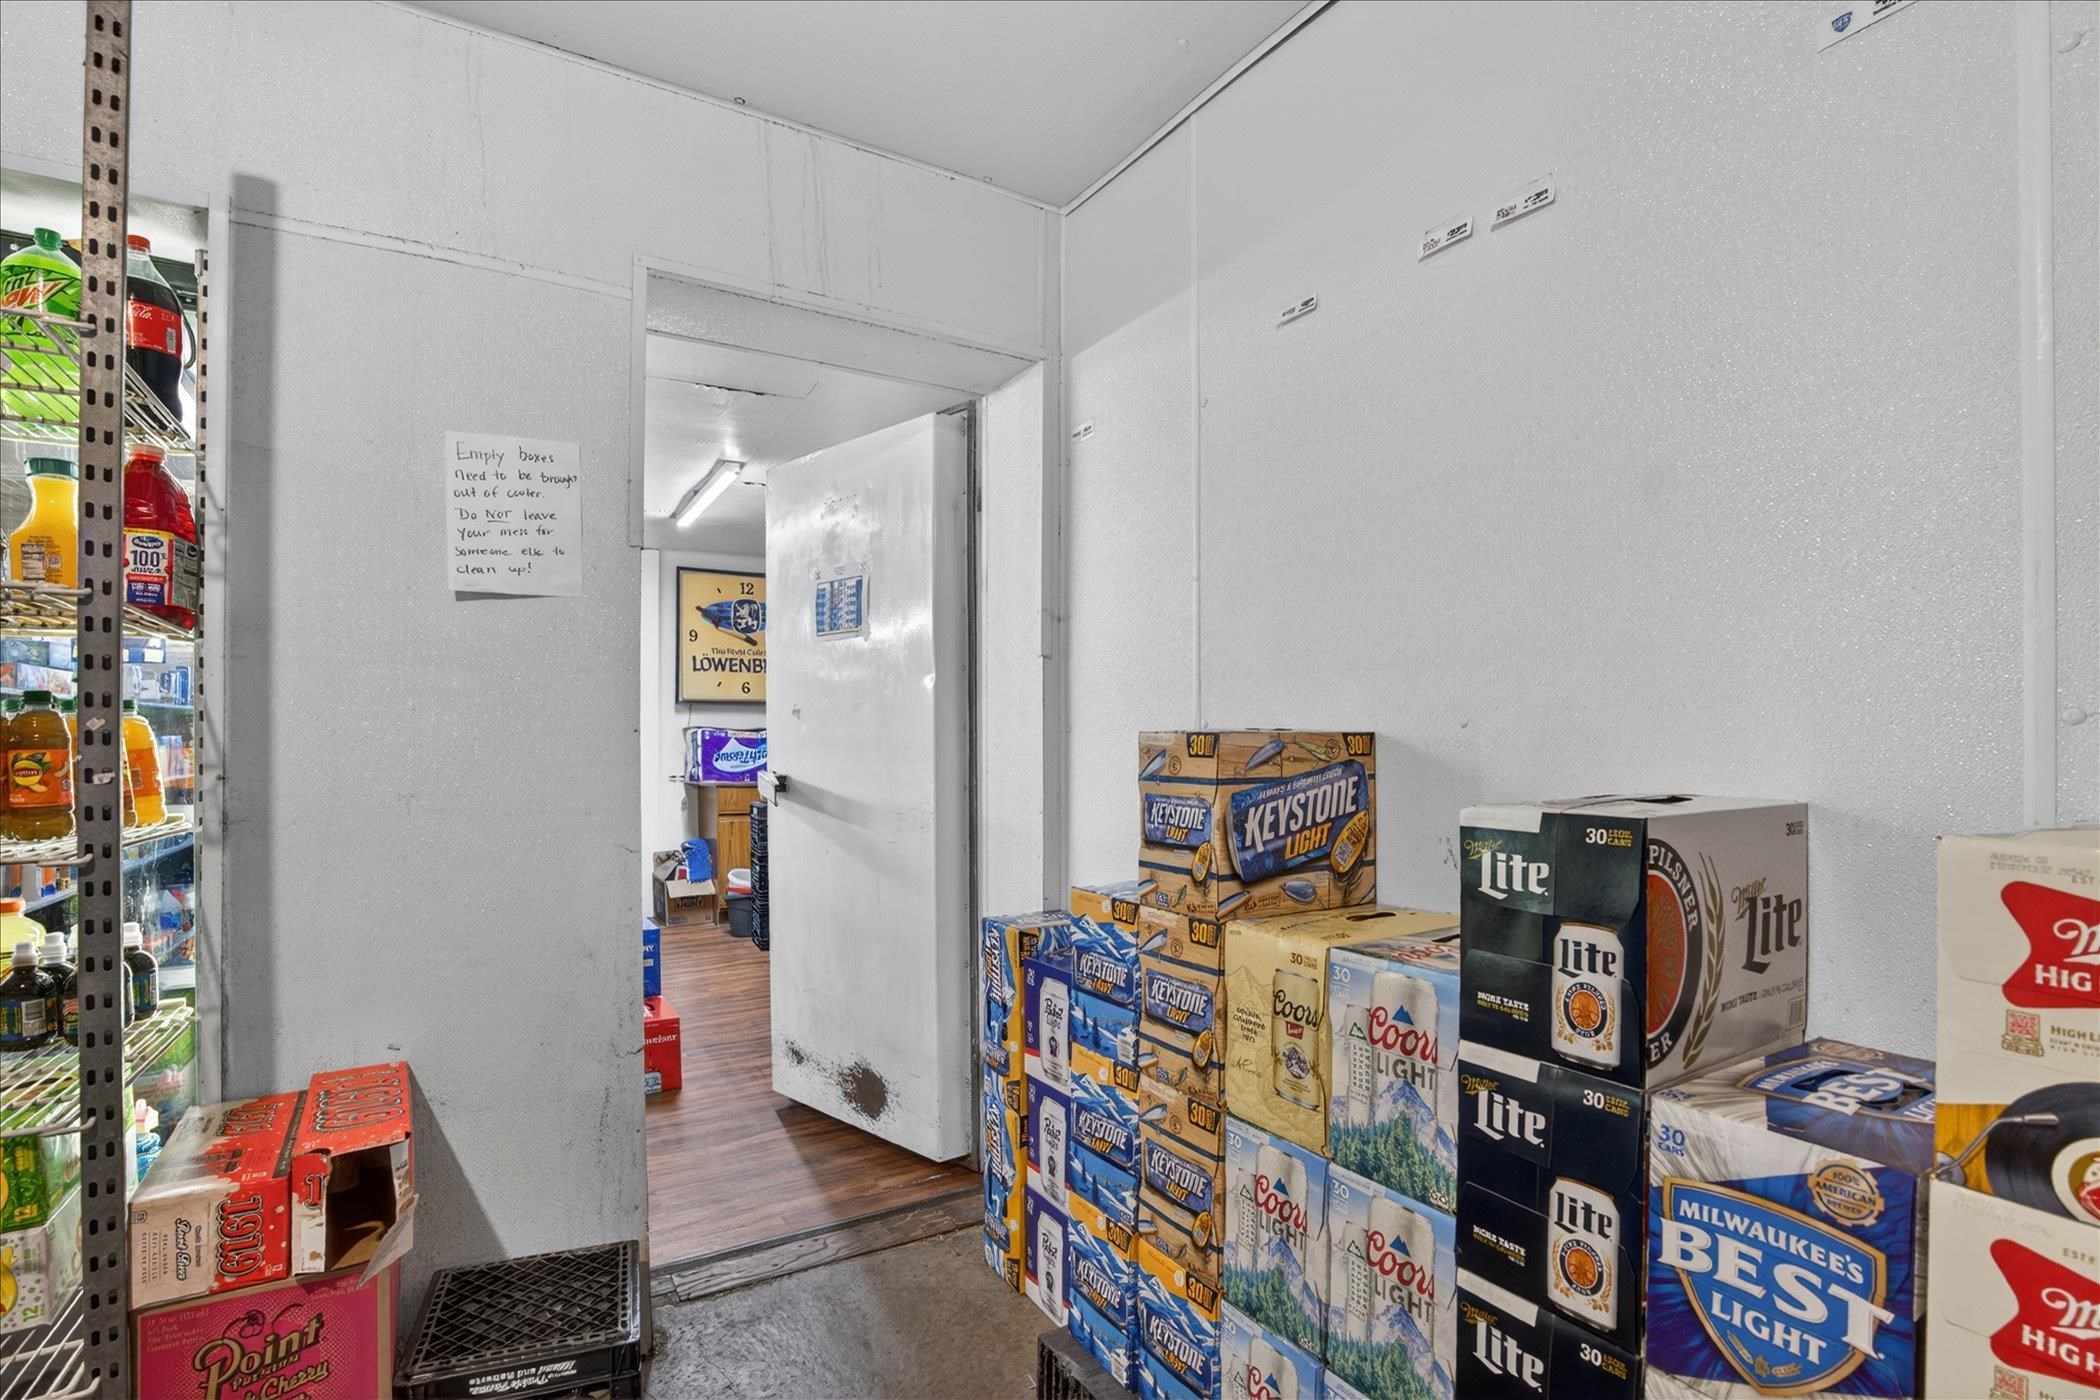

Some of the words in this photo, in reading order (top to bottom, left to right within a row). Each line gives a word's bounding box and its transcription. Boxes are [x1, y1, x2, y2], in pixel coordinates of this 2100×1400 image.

[456, 441, 504, 467] Empty
[519, 445, 554, 463] boxes
[453, 486, 477, 498] out
[483, 486, 499, 498] of
[493, 470, 507, 480] to
[518, 469, 532, 480] be
[454, 507, 477, 520] Do
[524, 509, 558, 520] leave
[536, 524, 555, 535] for
[508, 562, 532, 576] up!
[553, 546, 565, 555] to
[739, 582, 754, 596] 12
[688, 629, 698, 642] 9
[741, 681, 750, 694] 6
[1189, 734, 1205, 756] 30
[1347, 735, 1363, 756] 30
[1151, 801, 1207, 830] KEYSTONE
[1244, 775, 1359, 853] KEYSTONE
[1284, 822, 1333, 860] LIGHT
[1585, 827, 1608, 845] 30
[1476, 850, 1550, 900] Lite
[1650, 844, 1700, 933] PILSNER
[1192, 921, 1208, 943] 30
[1741, 893, 1802, 975] Lite
[1080, 952, 1128, 988] KEYSTONE
[1289, 952, 1303, 966] 30
[1333, 967, 1351, 983] 30
[1557, 937, 1617, 980] Lite
[1151, 979, 1208, 1016] KEYSTONE
[1272, 989, 1320, 1029] Coors
[1368, 1005, 1439, 1065] Coors
[1376, 1052, 1437, 1091] LIGHT
[1460, 1072, 1500, 1095] Miller
[1582, 1089, 1605, 1109] 30
[1802, 1067, 1927, 1116] BEST
[1079, 1109, 1128, 1150] KEYSTONE
[1473, 1086, 1546, 1149] Lite
[1659, 1124, 1686, 1146] 30
[1228, 1133, 1242, 1148] 30
[1151, 1148, 1208, 1200] KEYSTONE
[1331, 1179, 1349, 1199] 30
[1253, 1174, 1309, 1233] Coors
[1553, 1190, 1613, 1241] Lite
[216, 1194, 264, 1278] 1919
[1258, 1211, 1307, 1251] LIGHT
[1679, 1199, 1864, 1285] MILWAUKEE'S
[1076, 1258, 1121, 1309] KEYSTONE
[1366, 1230, 1435, 1301] Coors
[1374, 1273, 1435, 1325] LIGHT
[1656, 1217, 1896, 1361] BEST
[1223, 1320, 1236, 1335] 30
[1459, 1301, 1498, 1327] Miller
[1710, 1291, 1827, 1365] LIGHT
[193, 1311, 325, 1400] Point
[1149, 1315, 1206, 1376] KEYSTONE
[1472, 1320, 1545, 1393] Lite
[1580, 1343, 1602, 1366] 30
